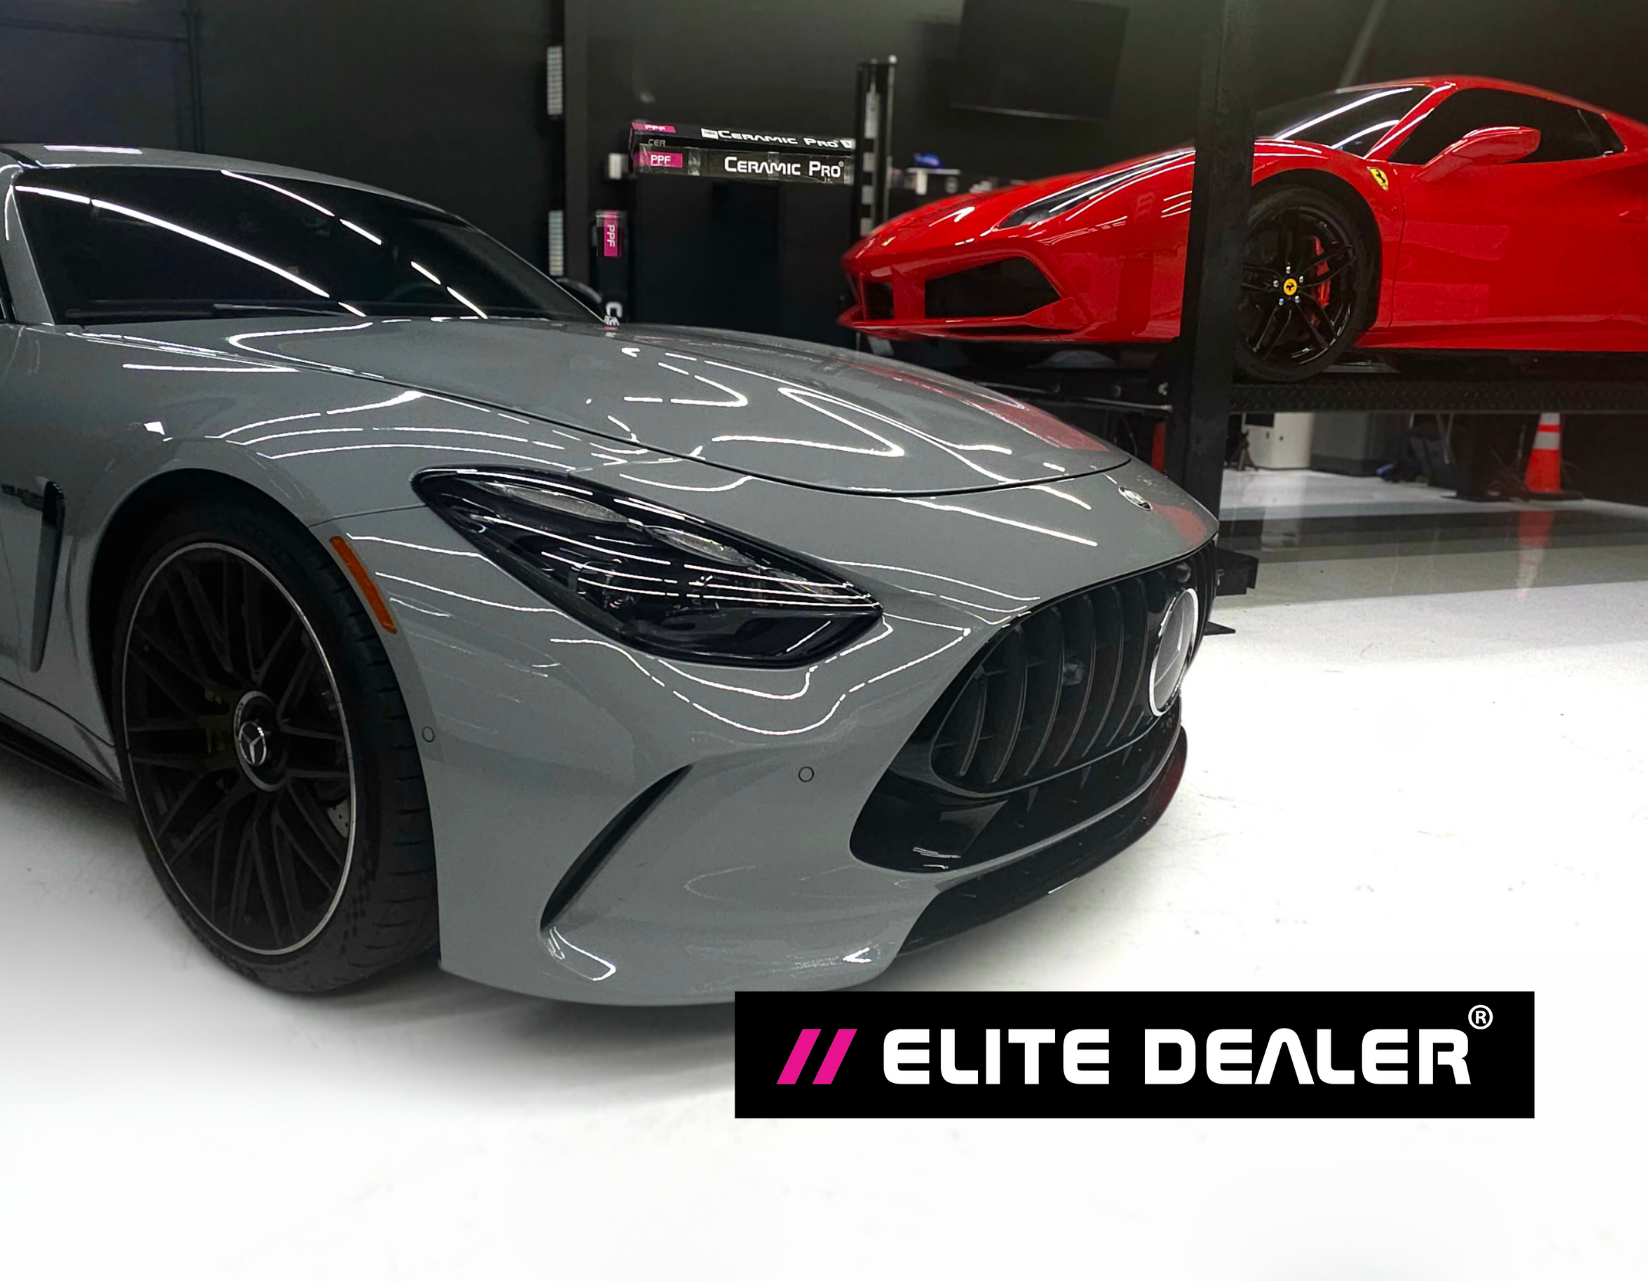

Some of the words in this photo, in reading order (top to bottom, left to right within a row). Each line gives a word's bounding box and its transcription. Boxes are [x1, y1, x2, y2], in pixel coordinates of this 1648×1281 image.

[718, 130, 798, 145] CERAMIC
[650, 154, 671, 165] PPF
[724, 156, 801, 176] CERAMIC
[606, 224, 615, 247] PPF
